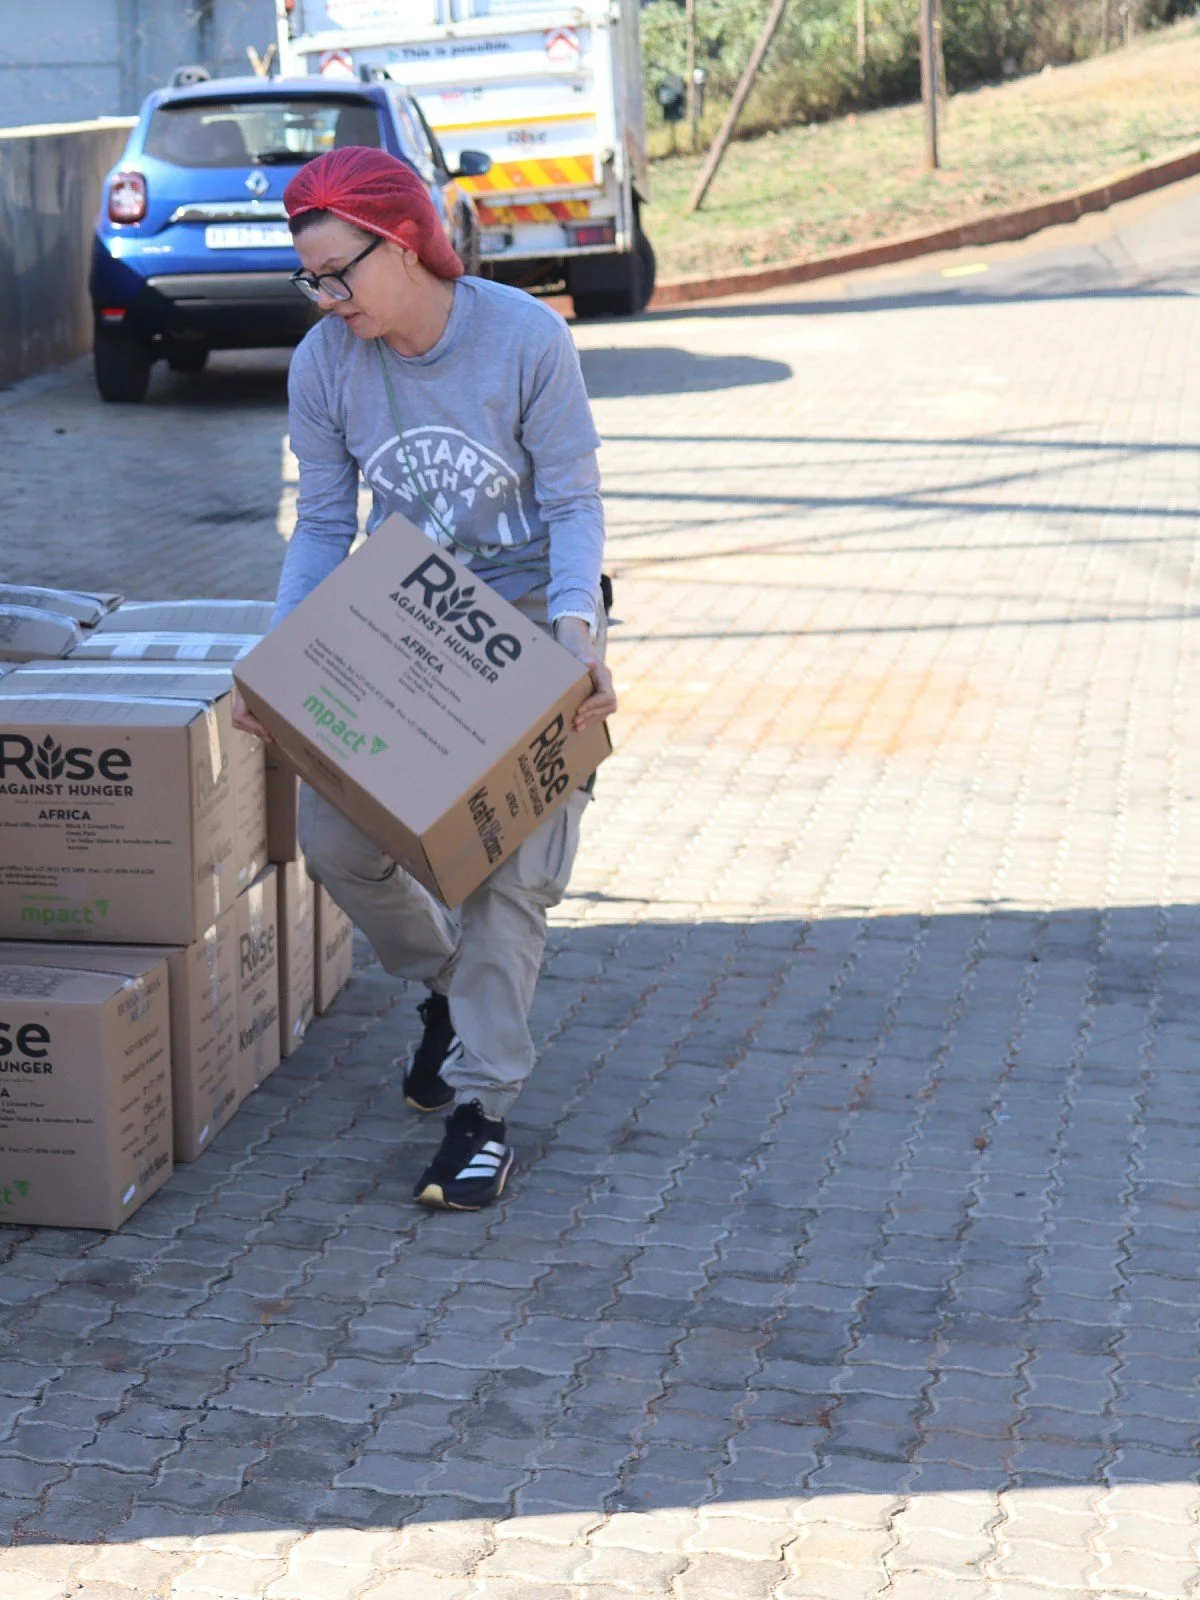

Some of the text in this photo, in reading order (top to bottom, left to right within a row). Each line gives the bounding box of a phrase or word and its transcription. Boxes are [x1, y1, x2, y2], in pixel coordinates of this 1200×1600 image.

[395, 467, 477, 509] WITH A
[396, 438, 509, 499] STARTS
[400, 552, 522, 669] Rise
[389, 592, 500, 684] AGAINST HUNGER
[400, 633, 445, 674] AFRICA
[303, 694, 366, 755] mpact
[68, 784, 133, 797] HUNGER
[37, 809, 91, 820] AFRICA
[20, 904, 94, 926] mpact
